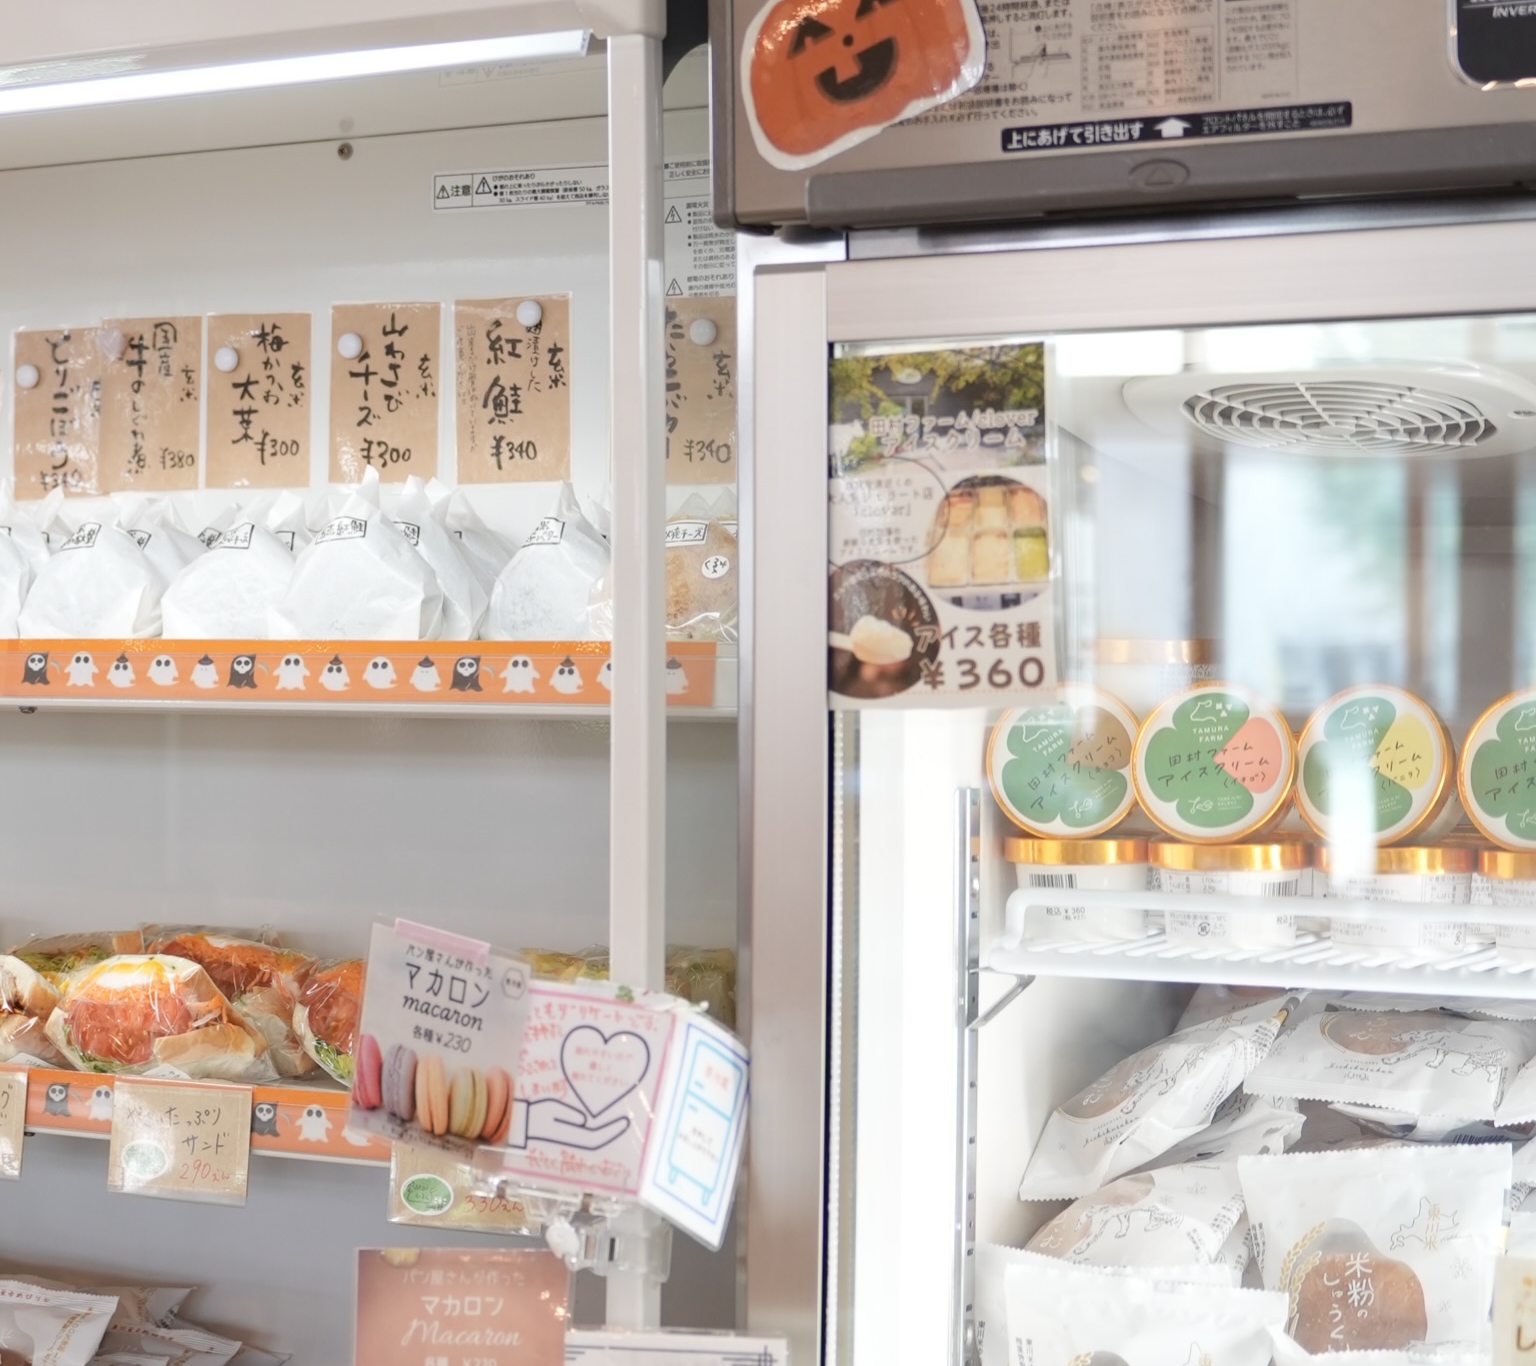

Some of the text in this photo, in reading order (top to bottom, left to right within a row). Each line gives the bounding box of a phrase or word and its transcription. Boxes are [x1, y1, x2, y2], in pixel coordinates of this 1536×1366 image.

[1006, 121, 1144, 149] 上にあげて引き出す
[451, 184, 471, 197] 注意
[492, 173, 535, 182] けがのおそれあり
[380, 312, 410, 413] 山わさび
[482, 319, 524, 425] 紅鮭
[349, 352, 381, 427] チーズ
[232, 373, 259, 445] 大葉
[254, 429, 300, 466] ¥300
[360, 438, 412, 468] ¥300
[490, 435, 538, 471] ¥340
[683, 438, 732, 463] ¥340
[881, 427, 1026, 456] アイスクリーム
[159, 447, 195, 469] ¥380
[916, 621, 1043, 652] アイス各種
[921, 658, 1045, 690] ¥360
[1032, 728, 1064, 754] TAMURA
[1193, 725, 1229, 735] TAMURA
[1199, 734, 1223, 743] FARM
[1043, 738, 1064, 757] FARM
[1169, 743, 1253, 767] 田村ファーム
[1158, 757, 1269, 787] アイスクリーム
[404, 962, 491, 1009] マカロン
[402, 994, 484, 1032] macaron
[412, 1024, 472, 1054] 各種¥230
[182, 1132, 229, 1155] サンド
[179, 1159, 230, 1184] 290えん
[464, 1194, 524, 1214] 330えん
[1423, 1203, 1441, 1252] 東川米
[401, 1267, 526, 1288] パン屋さんが作った
[1345, 1252, 1375, 1319] 米粉の
[419, 1293, 505, 1317] マカロン
[399, 1318, 523, 1347] Macaron
